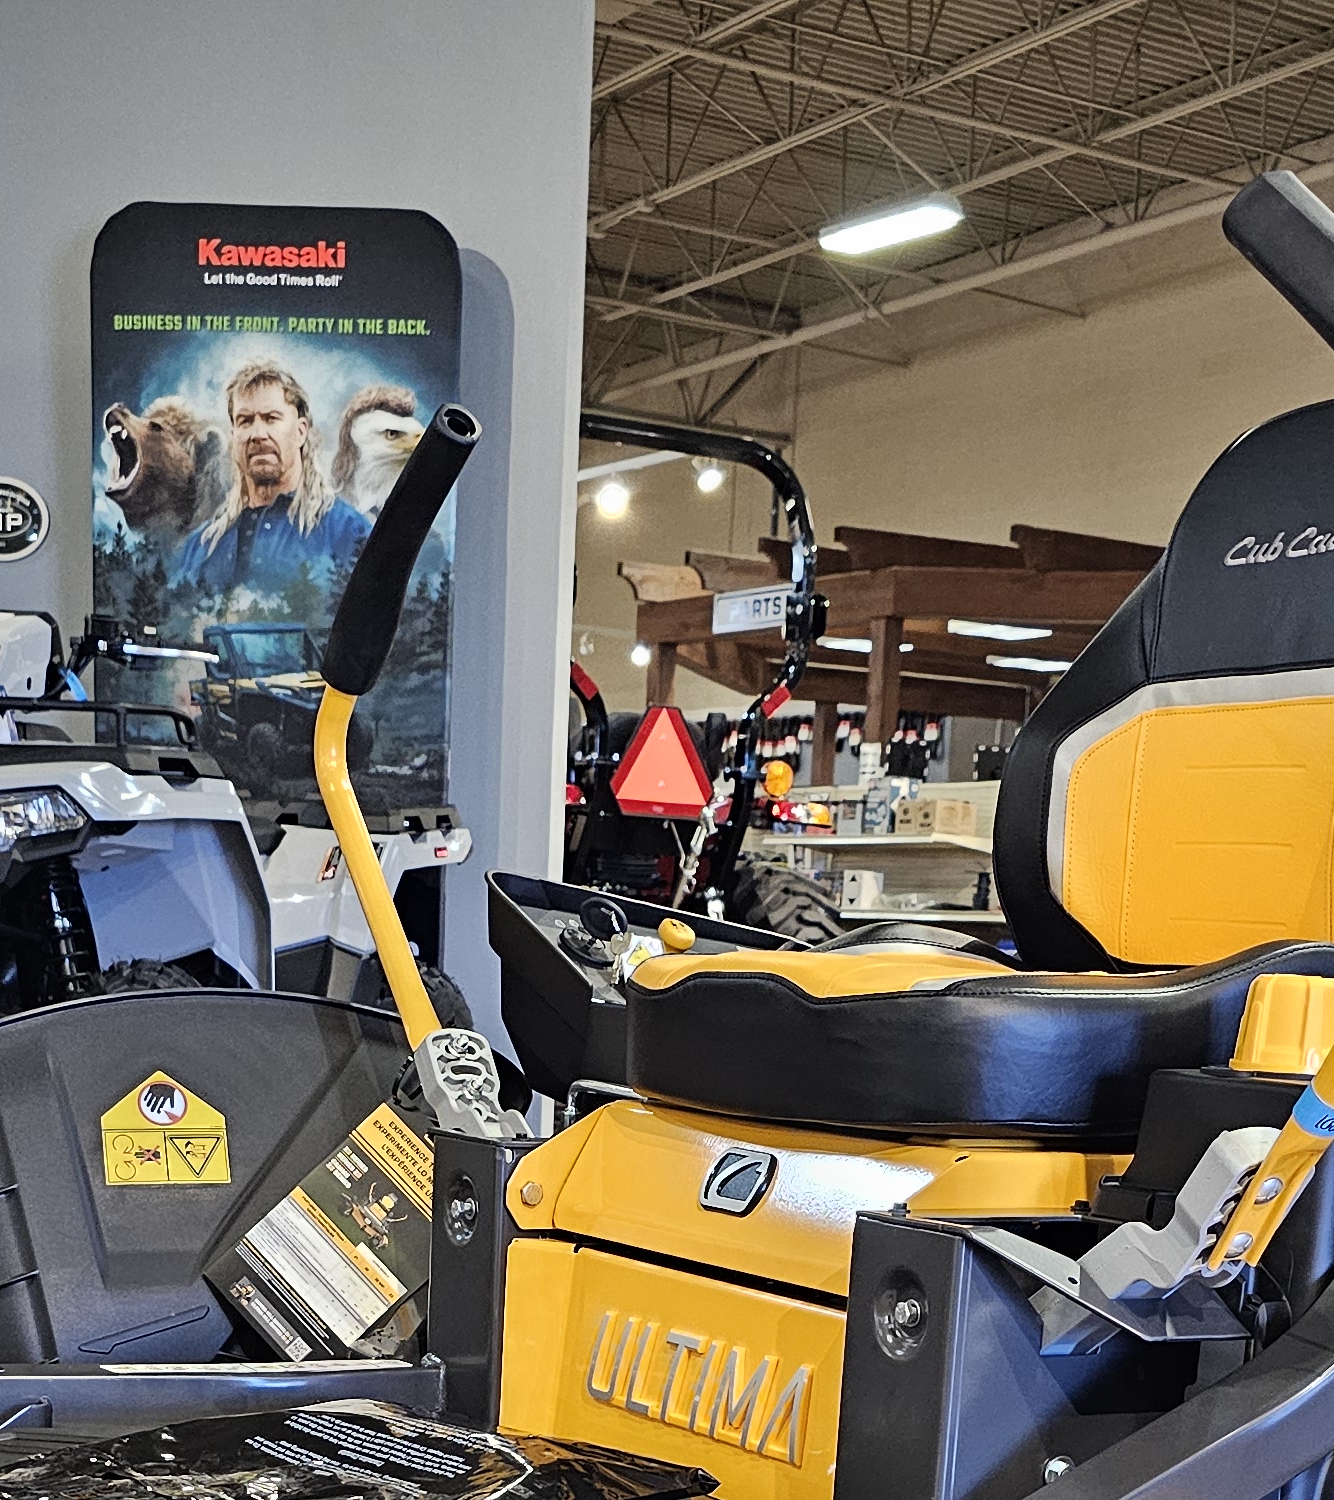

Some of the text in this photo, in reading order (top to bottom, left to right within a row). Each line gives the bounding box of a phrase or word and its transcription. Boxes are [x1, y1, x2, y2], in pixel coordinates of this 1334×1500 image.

[198, 237, 346, 269] Kawasaki
[203, 271, 223, 285] Let
[224, 272, 245, 285] the
[246, 272, 277, 286] Good
[279, 273, 314, 287] Times
[113, 314, 431, 336] BUSINESS IN THE FRONT. PARTY IN THE BACK.
[1223, 531, 1285, 567] Cub
[372, 1119, 419, 1168] EXPERIMENTE
[416, 1165, 428, 1177] LO
[388, 1120, 430, 1164] EXPERIENCE
[585, 1309, 815, 1469] ULTIMA
